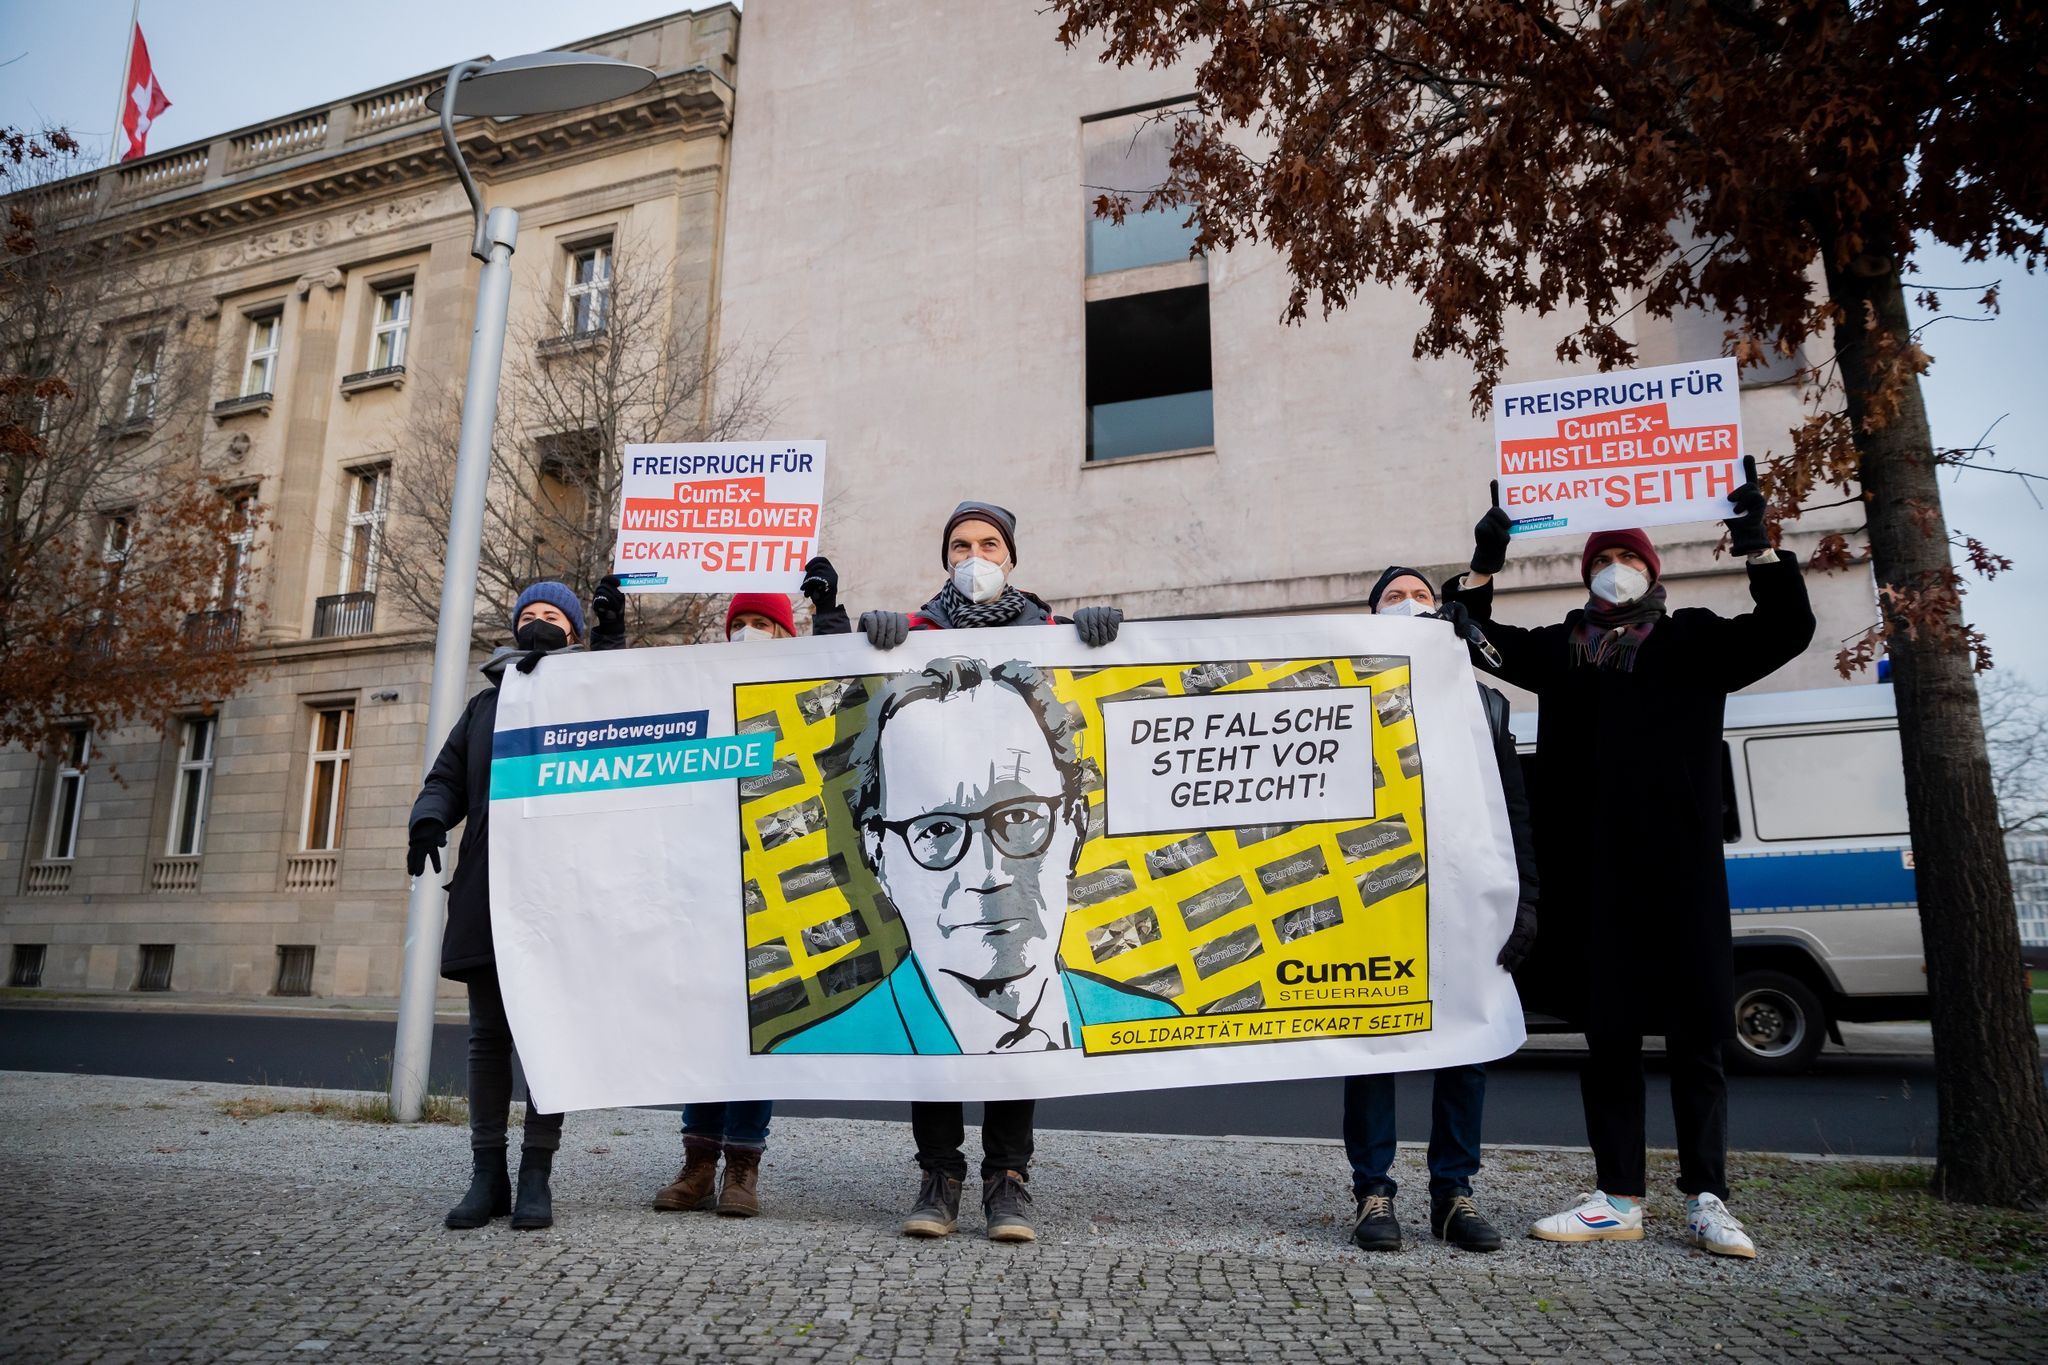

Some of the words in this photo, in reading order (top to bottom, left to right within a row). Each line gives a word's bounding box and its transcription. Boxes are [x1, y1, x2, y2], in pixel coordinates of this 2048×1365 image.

[1504, 380, 1664, 417] FREISPRUCH
[1671, 370, 1723, 398] FÜR
[1563, 413, 1663, 440] CumEx-
[632, 454, 764, 475] FREISPRUCH
[770, 449, 813, 473] FÜR
[1503, 429, 1732, 472] WHISTLEBLOWER
[678, 484, 760, 503] CumEx-
[1506, 477, 1604, 506] ECKART
[1604, 463, 1735, 508] SEITH
[625, 508, 812, 528] WHISTLEBLOWER
[622, 542, 703, 560] ECKART
[701, 541, 809, 572] SEITH
[543, 718, 697, 748] Bürgerbewegung
[1130, 715, 1195, 745] DER
[1204, 704, 1354, 741] FALSCHE
[537, 742, 762, 787] FINANZWENDE
[1151, 743, 1261, 776] STEHT
[1273, 739, 1340, 768] VOR
[1170, 773, 1328, 808] GERICHT!
[1152, 843, 1202, 869] CumEx
[1348, 831, 1399, 856] CumEx
[1262, 859, 1314, 884] CumEx
[1368, 867, 1418, 893] CumEx
[1073, 873, 1124, 899] CumEx
[1185, 890, 1237, 915] CumEx
[1284, 908, 1335, 934] CumEx
[1196, 942, 1247, 968] CumEx
[1275, 955, 1417, 986] CumEx
[1279, 984, 1409, 1001] STEUERRAUB
[1110, 1020, 1245, 1046] SOLIDARITÄT
[1249, 1019, 1286, 1037] MIT
[1292, 1014, 1362, 1034] ECKART
[1367, 1011, 1425, 1031] SEITH
